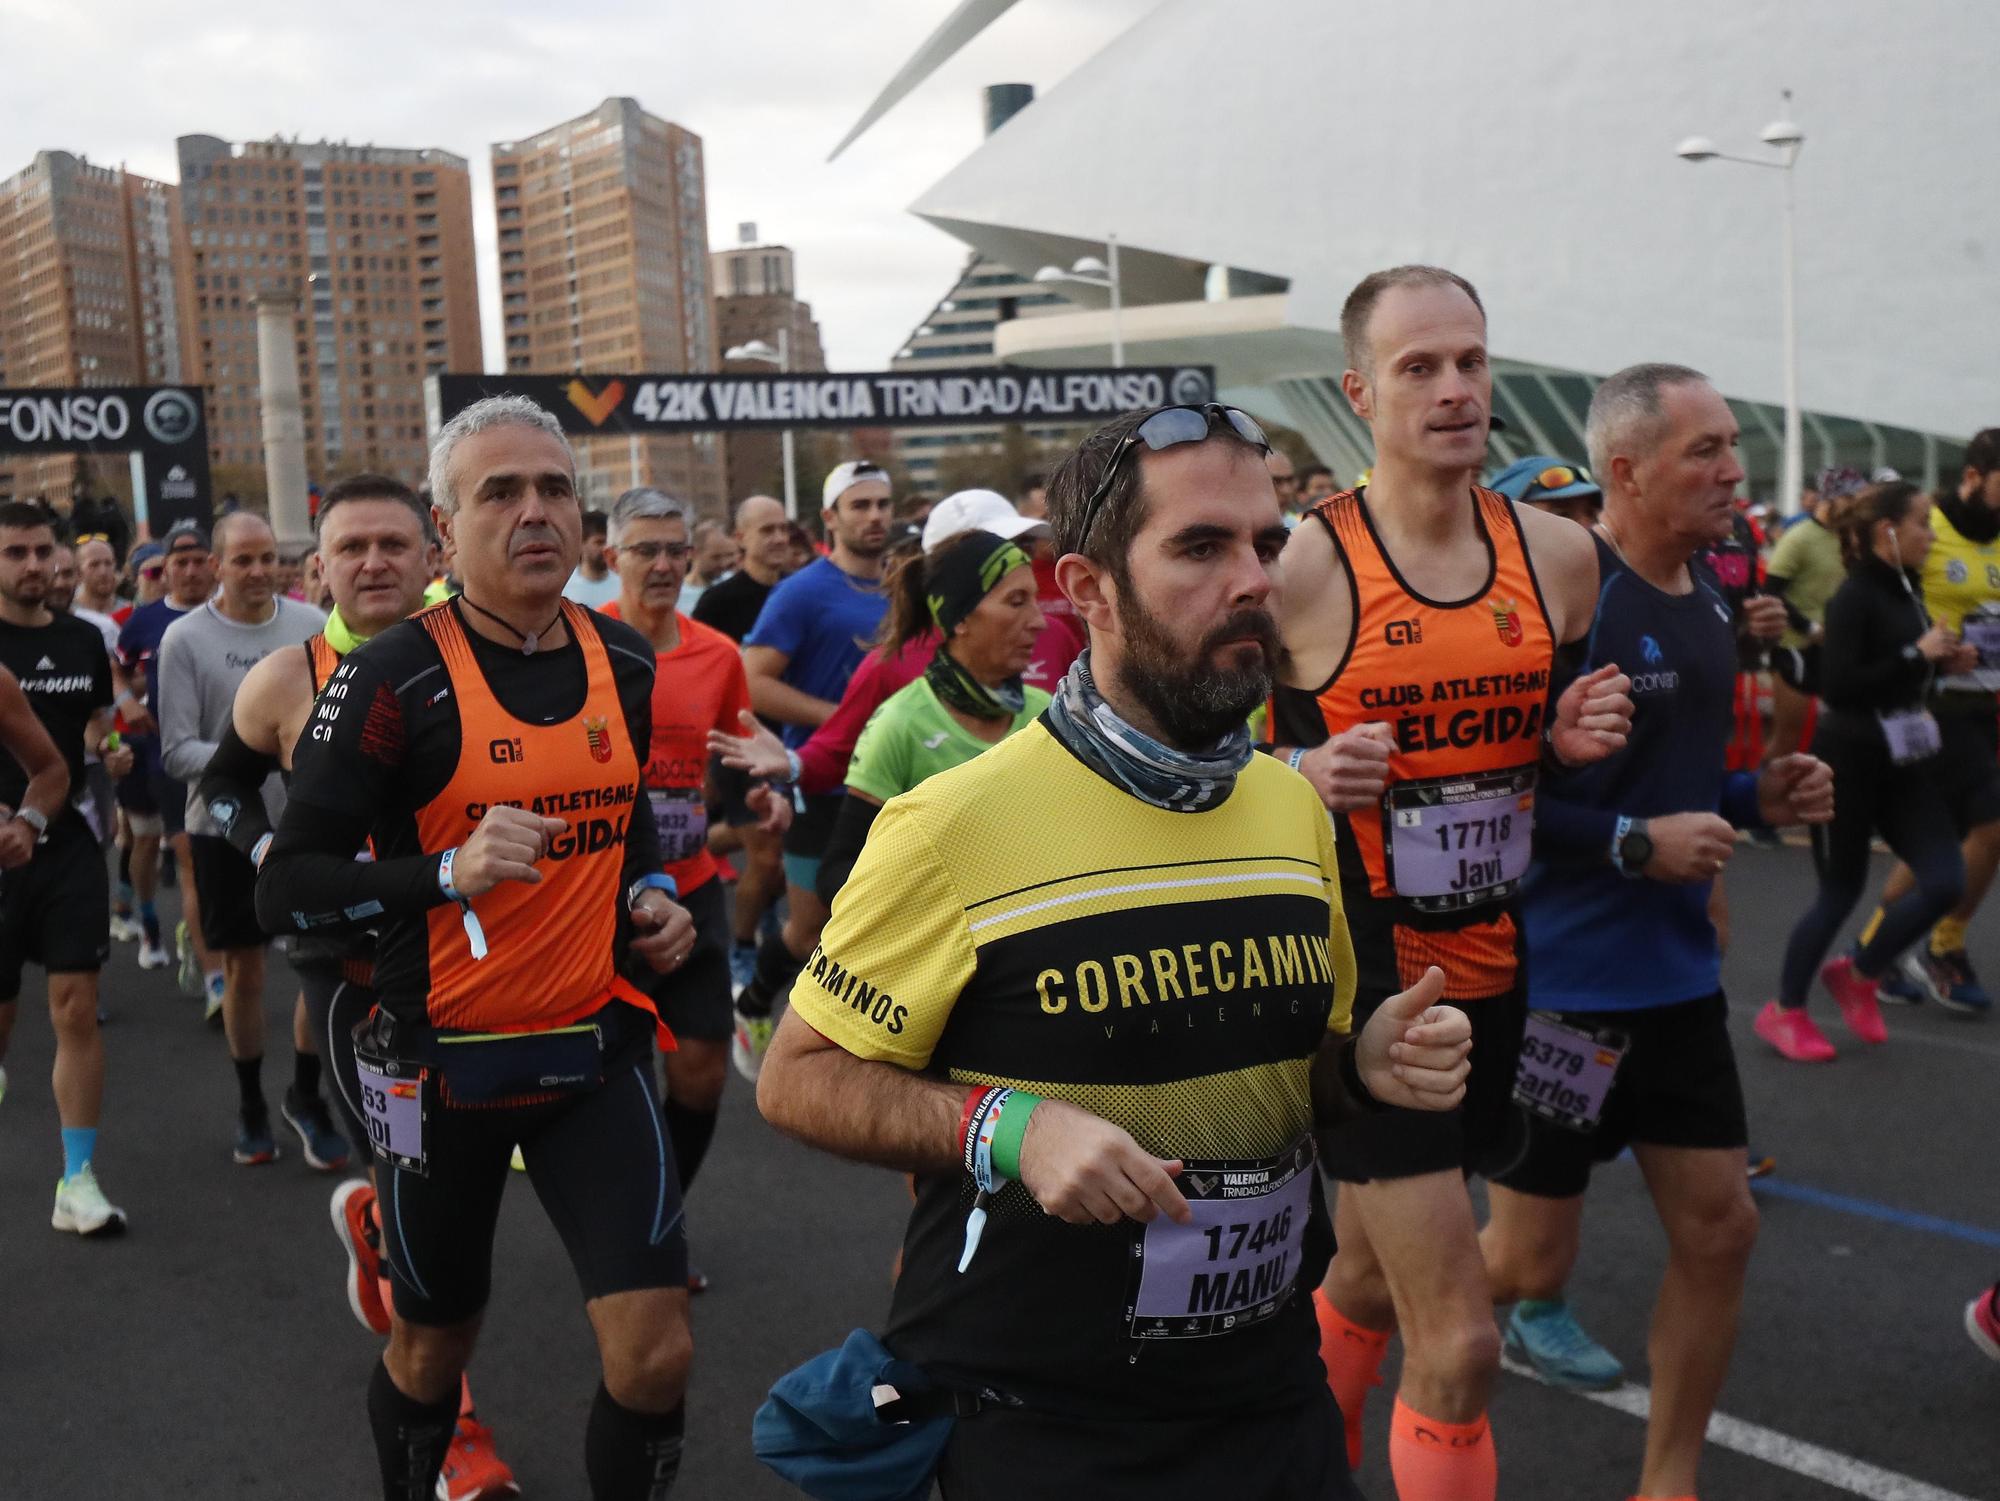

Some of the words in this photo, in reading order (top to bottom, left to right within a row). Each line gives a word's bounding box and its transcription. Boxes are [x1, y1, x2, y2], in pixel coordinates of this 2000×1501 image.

[633, 381, 708, 421] 42K
[710, 379, 875, 421] VALENCIA
[875, 377, 1022, 417] TRINIDAD
[1023, 372, 1164, 413] ALFONSO
[1360, 683, 1424, 709] CLUB
[1364, 703, 1542, 753] ÈLGIDA
[465, 800, 523, 820] CL
[531, 784, 634, 816] ATLETISME
[541, 814, 625, 861] GIDA
[1435, 814, 1512, 851] 17718
[1451, 850, 1503, 890] Javi
[965, 1119, 980, 1164] MARATÓN
[974, 1087, 1002, 1121] VALENCIA
[1222, 1184, 1260, 1198] TRINIDAD
[1223, 1171, 1270, 1186] VALENCIA
[1204, 1205, 1292, 1262] 17446
[1187, 1250, 1289, 1314] MANU
